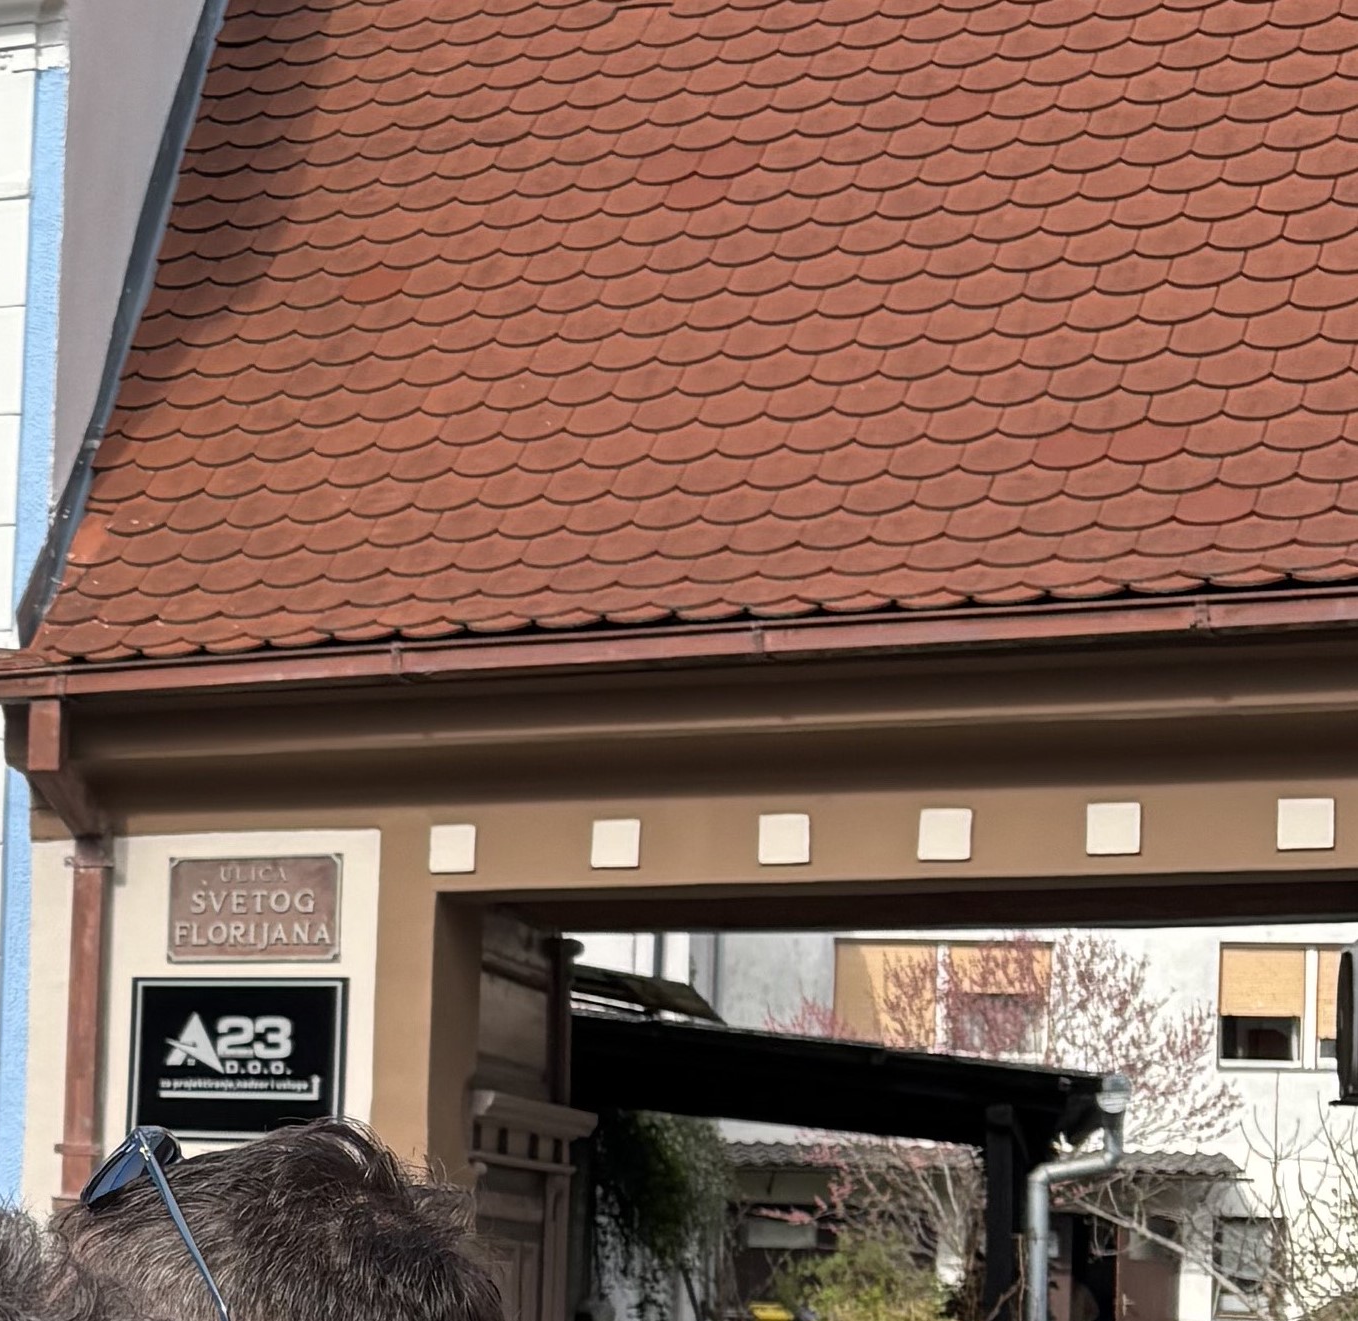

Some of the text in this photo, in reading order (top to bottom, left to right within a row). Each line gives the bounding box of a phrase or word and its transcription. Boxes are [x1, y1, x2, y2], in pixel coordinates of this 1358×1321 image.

[220, 865, 288, 883] ULICA
[190, 887, 316, 915] SVETOG
[174, 919, 333, 951] FLORIJANA
[165, 1011, 293, 1074] A23
[225, 1060, 293, 1075] D.O.O.
